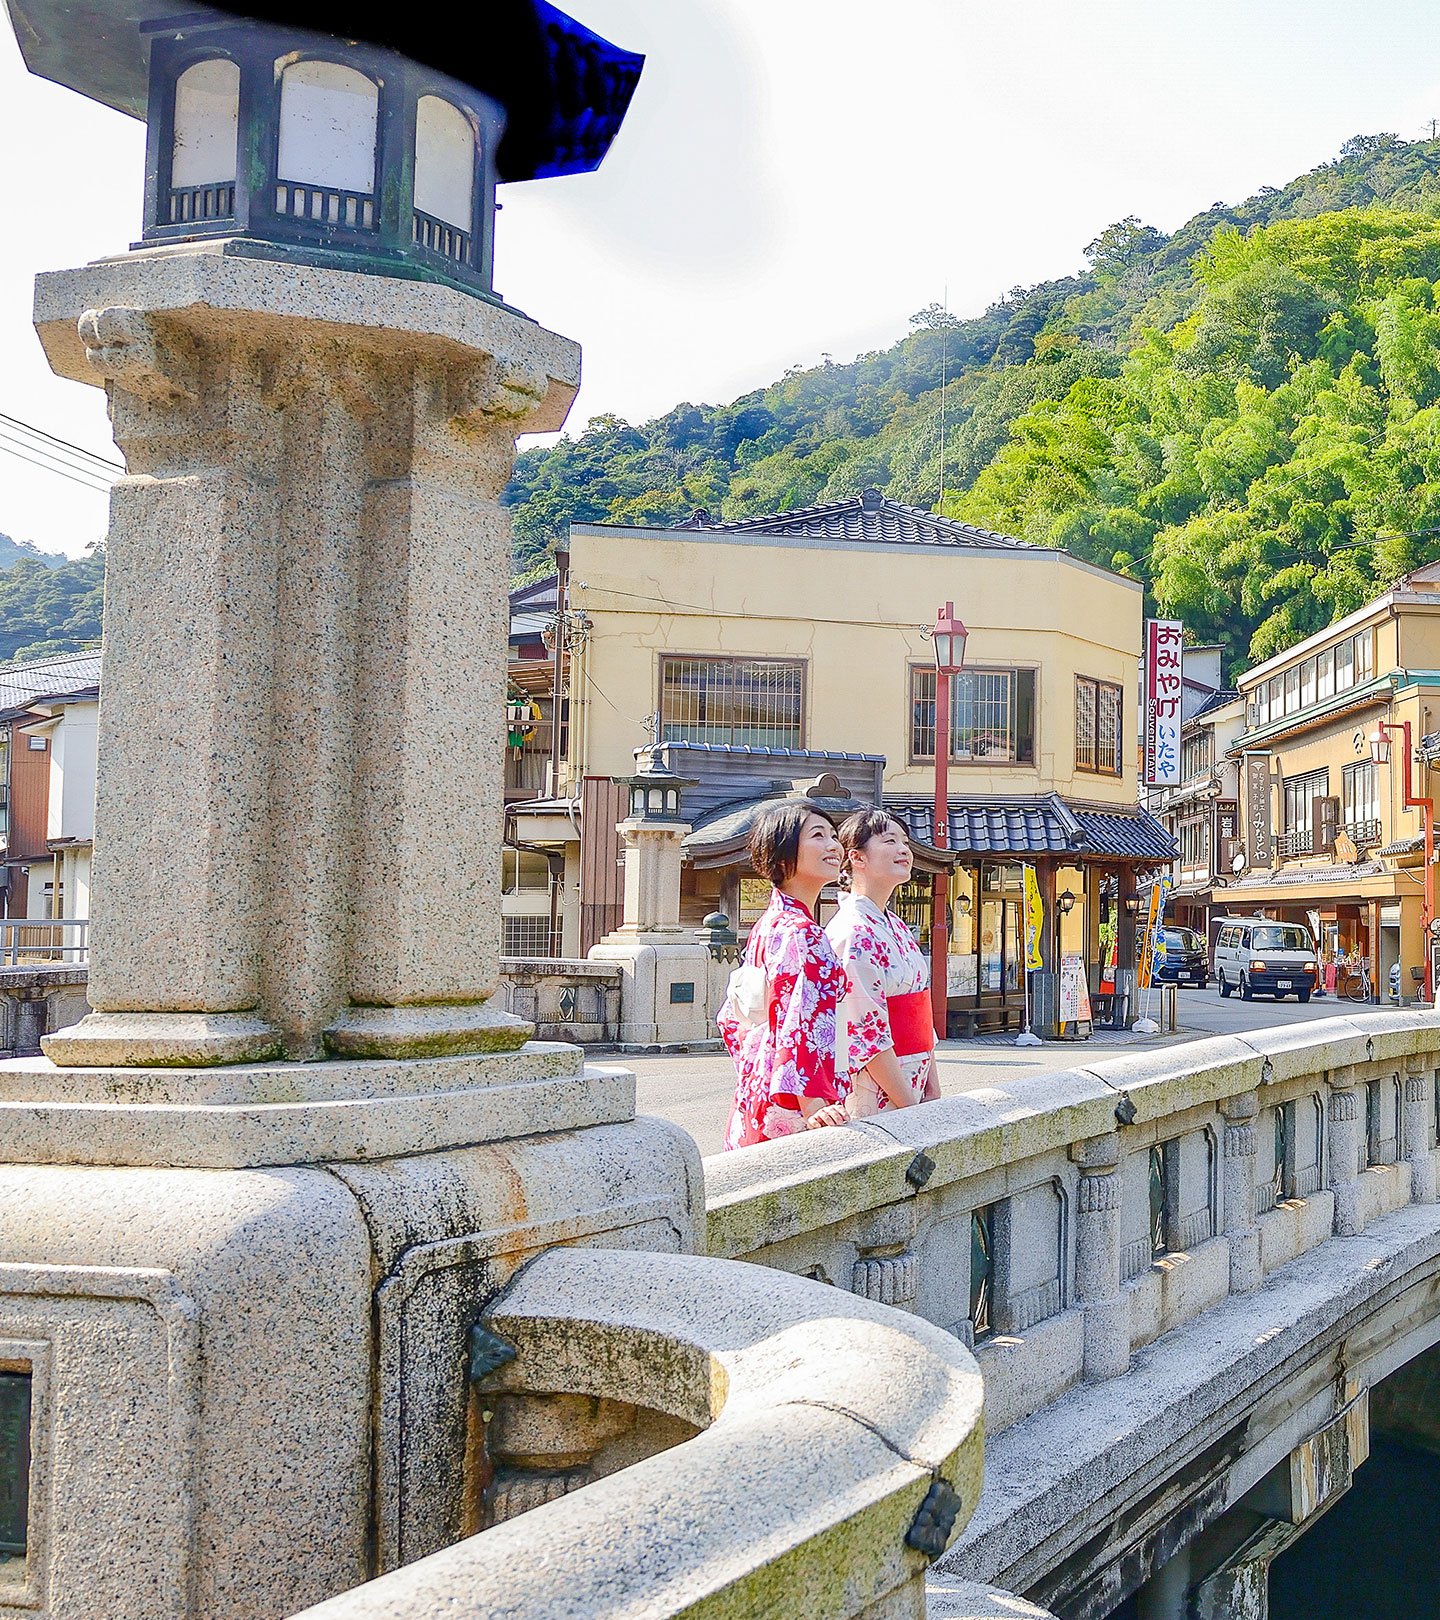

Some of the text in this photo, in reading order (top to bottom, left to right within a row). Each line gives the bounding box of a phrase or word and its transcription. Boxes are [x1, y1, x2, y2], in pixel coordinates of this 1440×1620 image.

[1148, 698, 1156, 753] Souvenir
[1157, 626, 1182, 778] おみやげ いたや
[1252, 812, 1268, 860] みなとや
